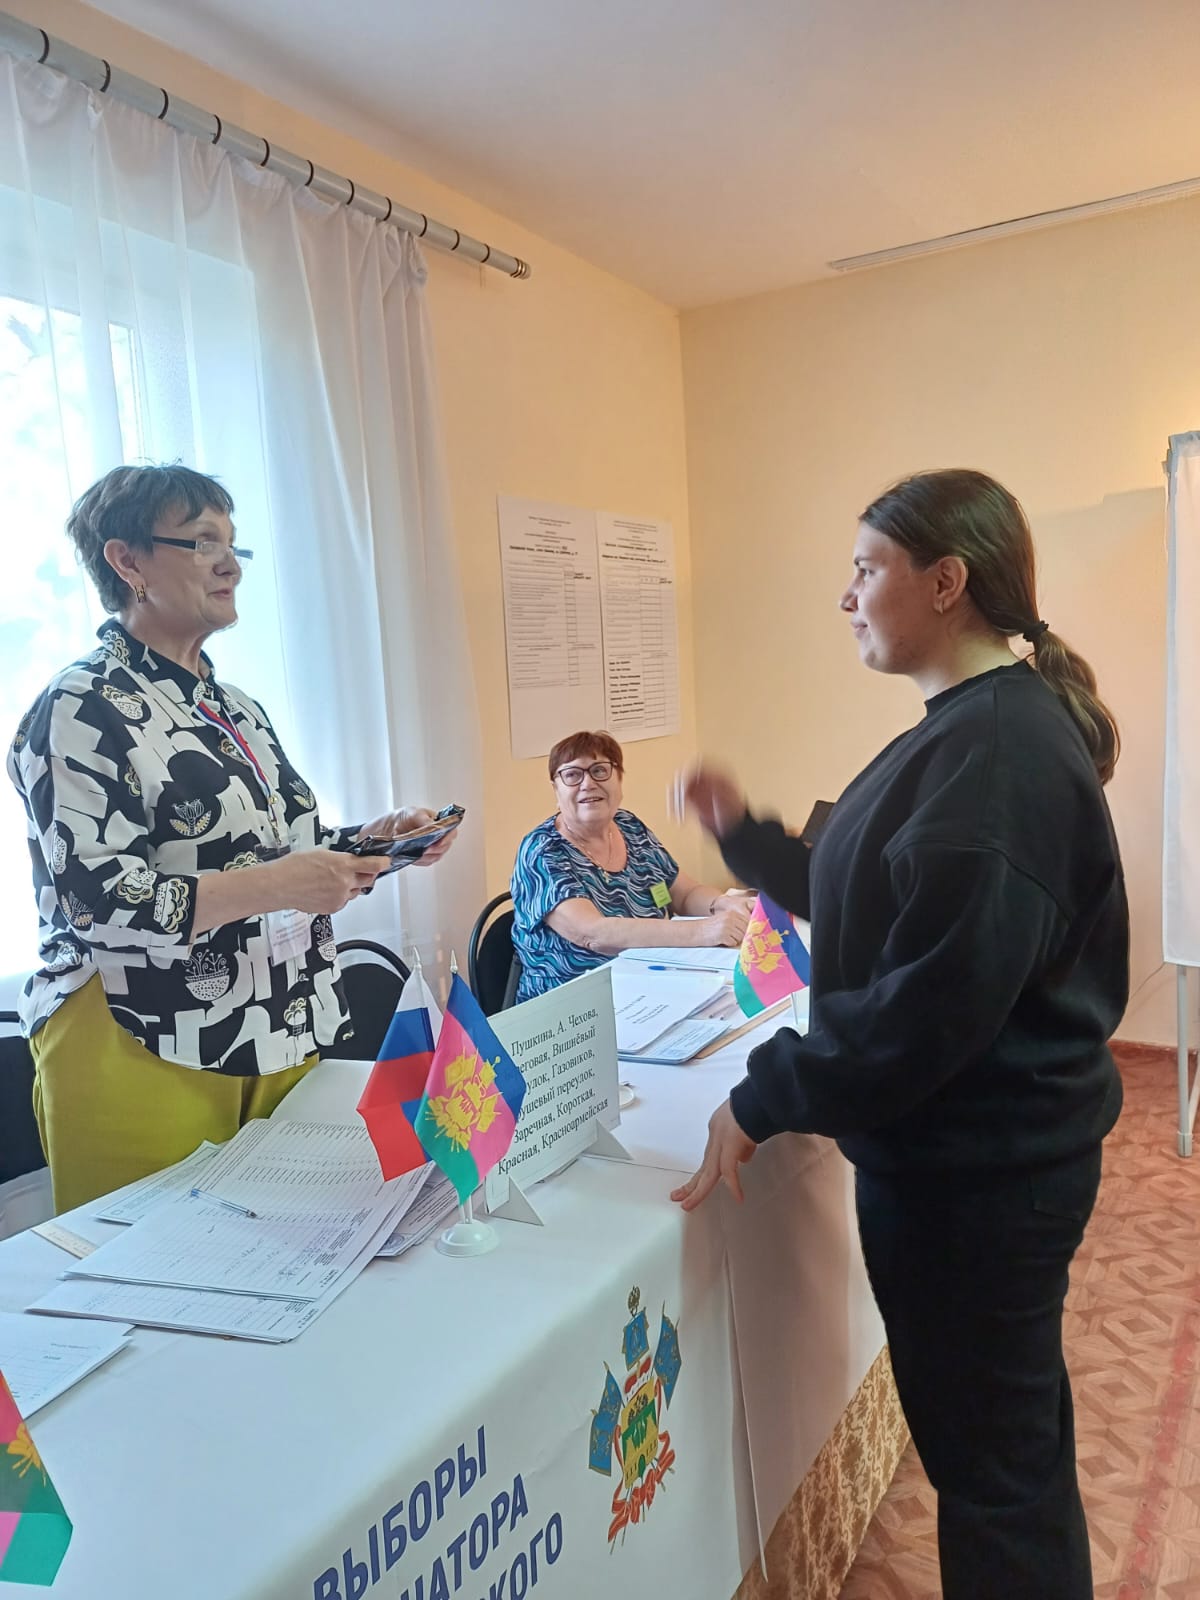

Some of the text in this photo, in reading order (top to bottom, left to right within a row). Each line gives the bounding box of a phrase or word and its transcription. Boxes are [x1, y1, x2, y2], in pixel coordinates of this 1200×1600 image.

[511, 1029, 555, 1057] Пушкина,
[556, 1020, 567, 1035] А.
[567, 1008, 599, 1028] Чехова,
[518, 1024, 596, 1074] еговая, Вишнёвый
[526, 1049, 595, 1096] улок, Газовиков,
[514, 1112, 556, 1144] Заречная,
[519, 1086, 556, 1121] ушевый
[498, 1098, 609, 1175] Красная, Красноармейская
[313, 1424, 487, 1600] ВЫБОРЫ
